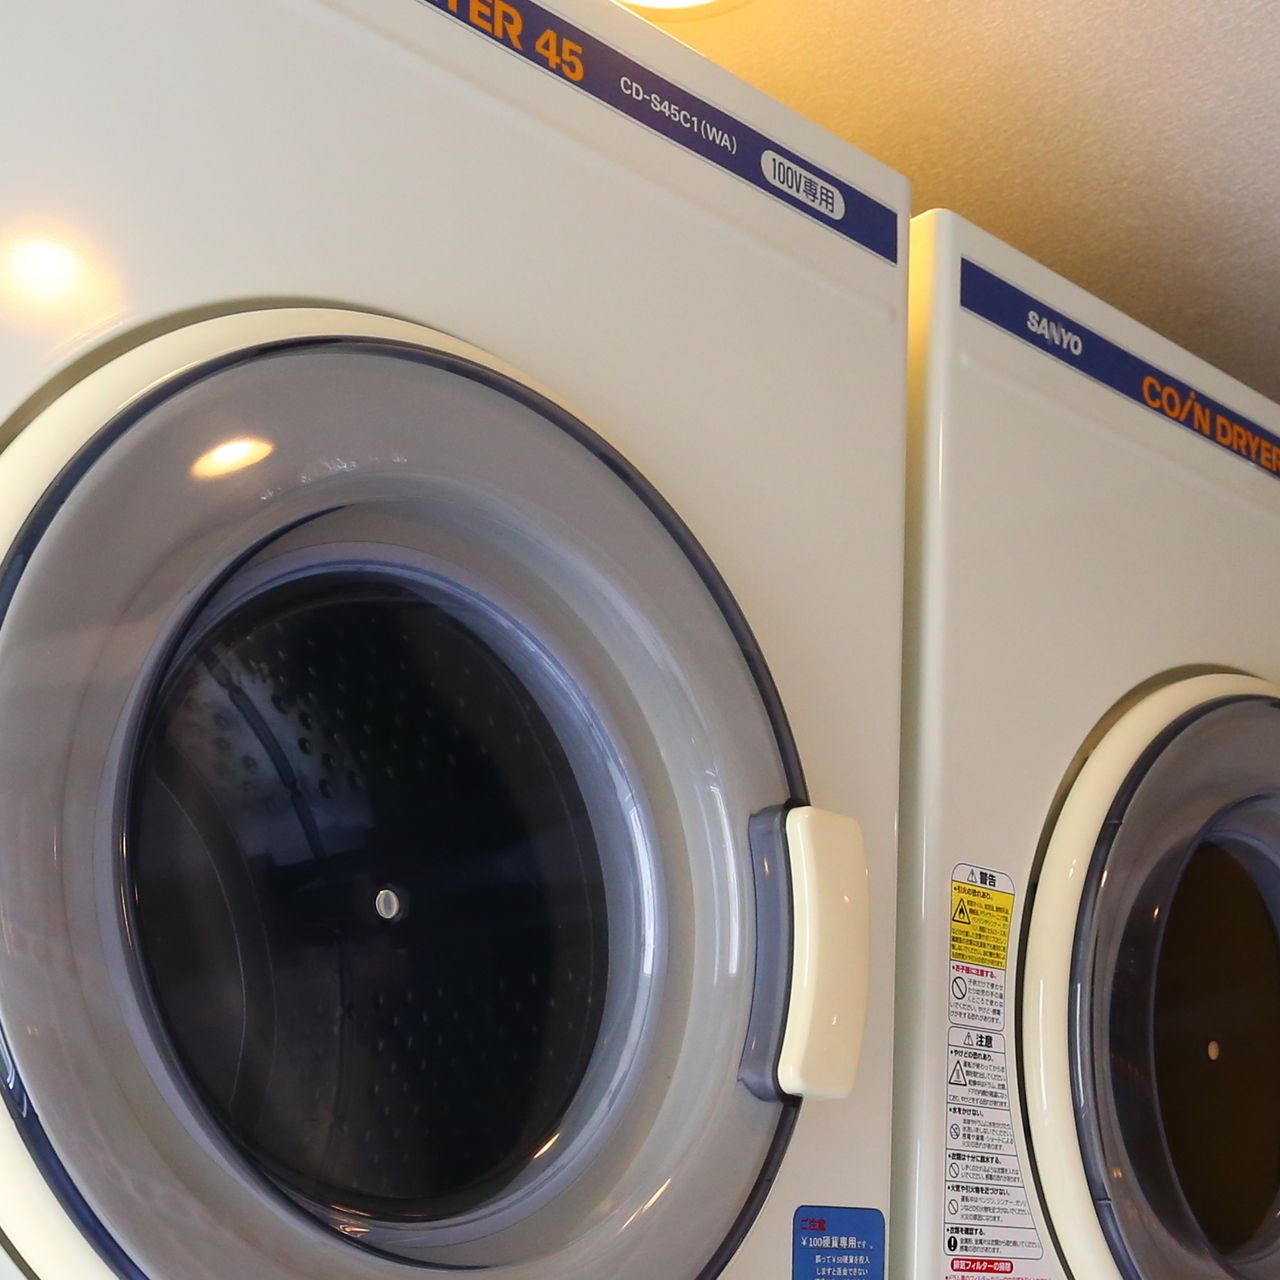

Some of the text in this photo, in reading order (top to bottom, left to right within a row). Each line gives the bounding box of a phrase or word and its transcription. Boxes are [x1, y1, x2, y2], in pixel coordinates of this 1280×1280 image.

[535, 28, 585, 82] 45
[621, 77, 737, 155] CD-S45C1(WA)
[771, 157, 836, 214] 100V専用
[1027, 310, 1083, 356] SANYO
